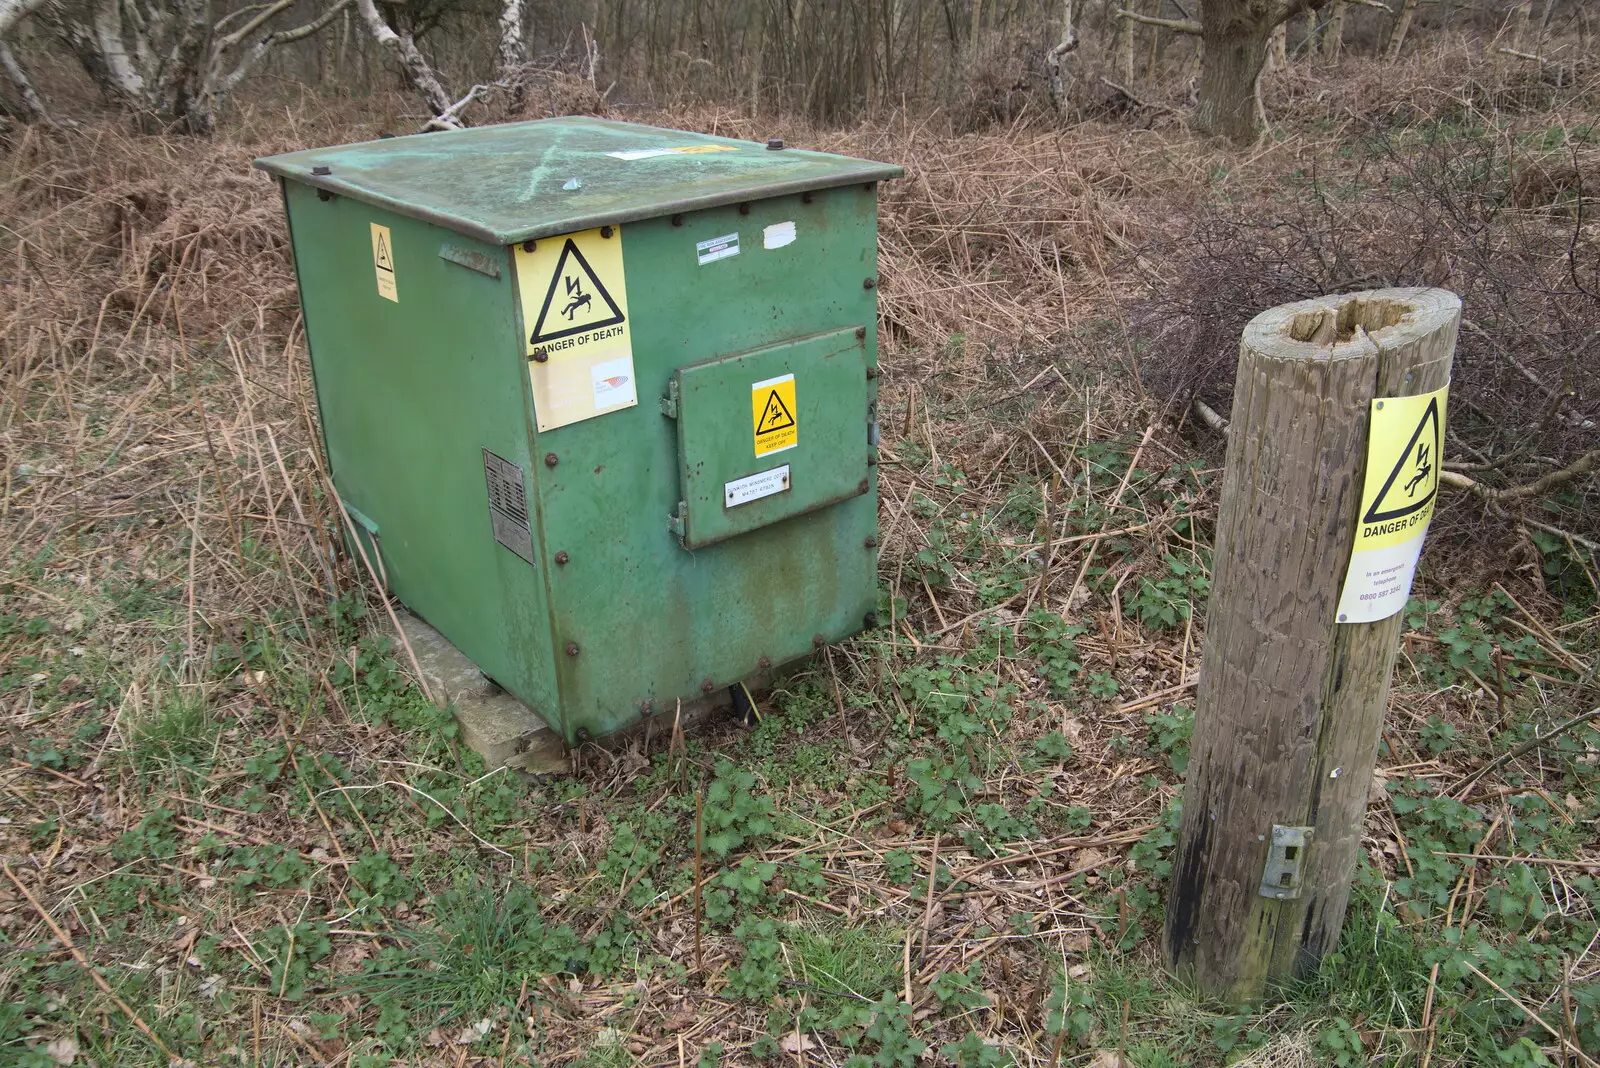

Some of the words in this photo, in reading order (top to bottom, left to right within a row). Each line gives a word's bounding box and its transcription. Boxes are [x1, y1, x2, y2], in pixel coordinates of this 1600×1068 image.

[533, 338, 575, 353] DANGER
[577, 334, 590, 345] OF
[593, 326, 624, 342] DEATH
[756, 436, 774, 445] DANGER
[781, 429, 795, 438] DEATH
[1363, 519, 1407, 538] DANGER
[1409, 513, 1420, 527] OF
[1359, 592, 1377, 601] 0800
